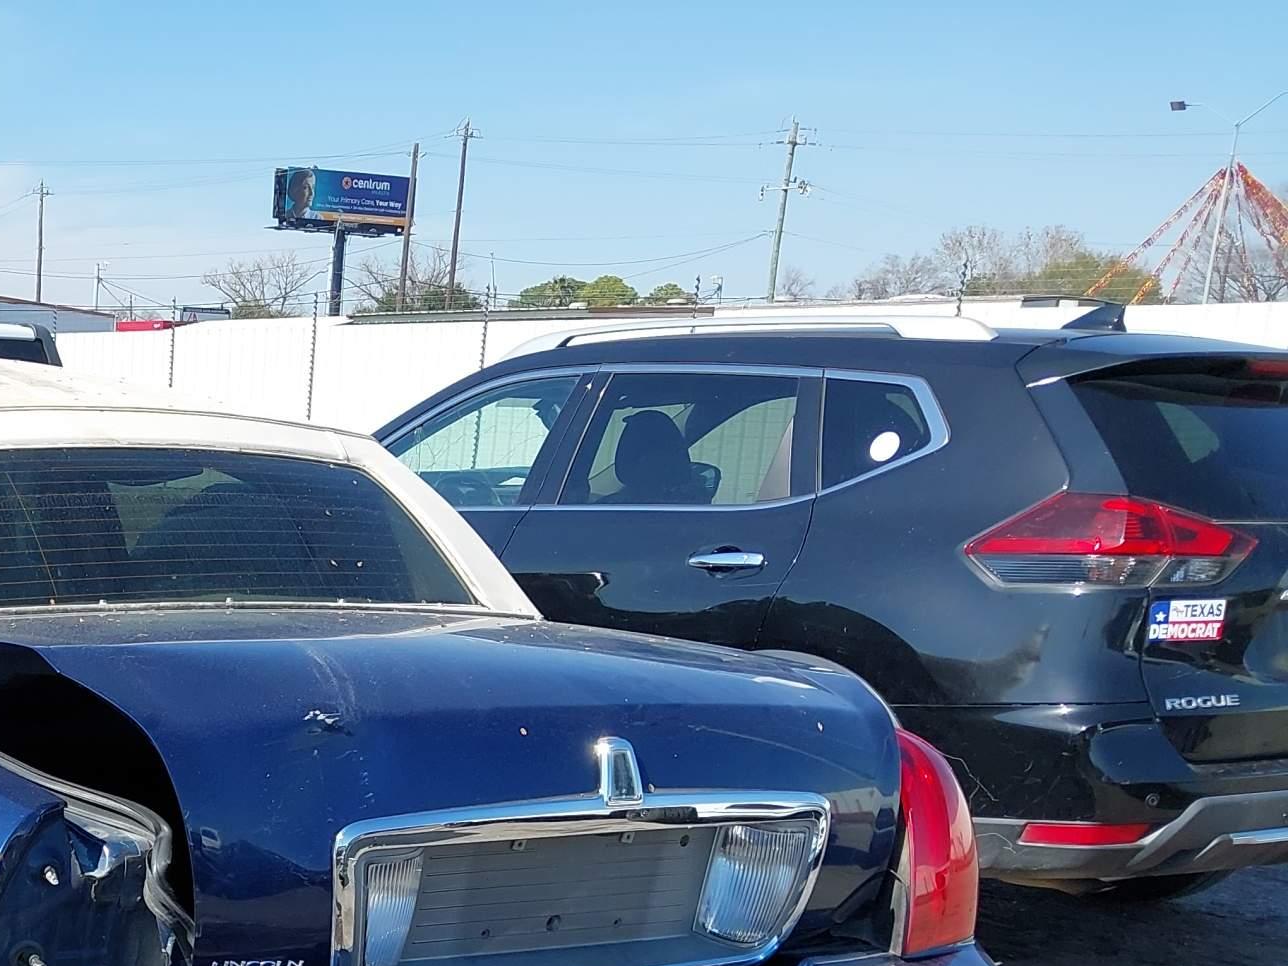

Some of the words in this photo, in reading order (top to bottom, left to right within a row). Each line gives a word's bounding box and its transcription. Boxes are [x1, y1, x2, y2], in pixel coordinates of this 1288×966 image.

[352, 178, 391, 191] centrum
[376, 200, 388, 208] Your
[389, 201, 402, 210] Way
[1184, 603, 1223, 618] TEXAS
[1149, 623, 1220, 639] DEMOCRAT
[1165, 694, 1241, 711] ROGUE
